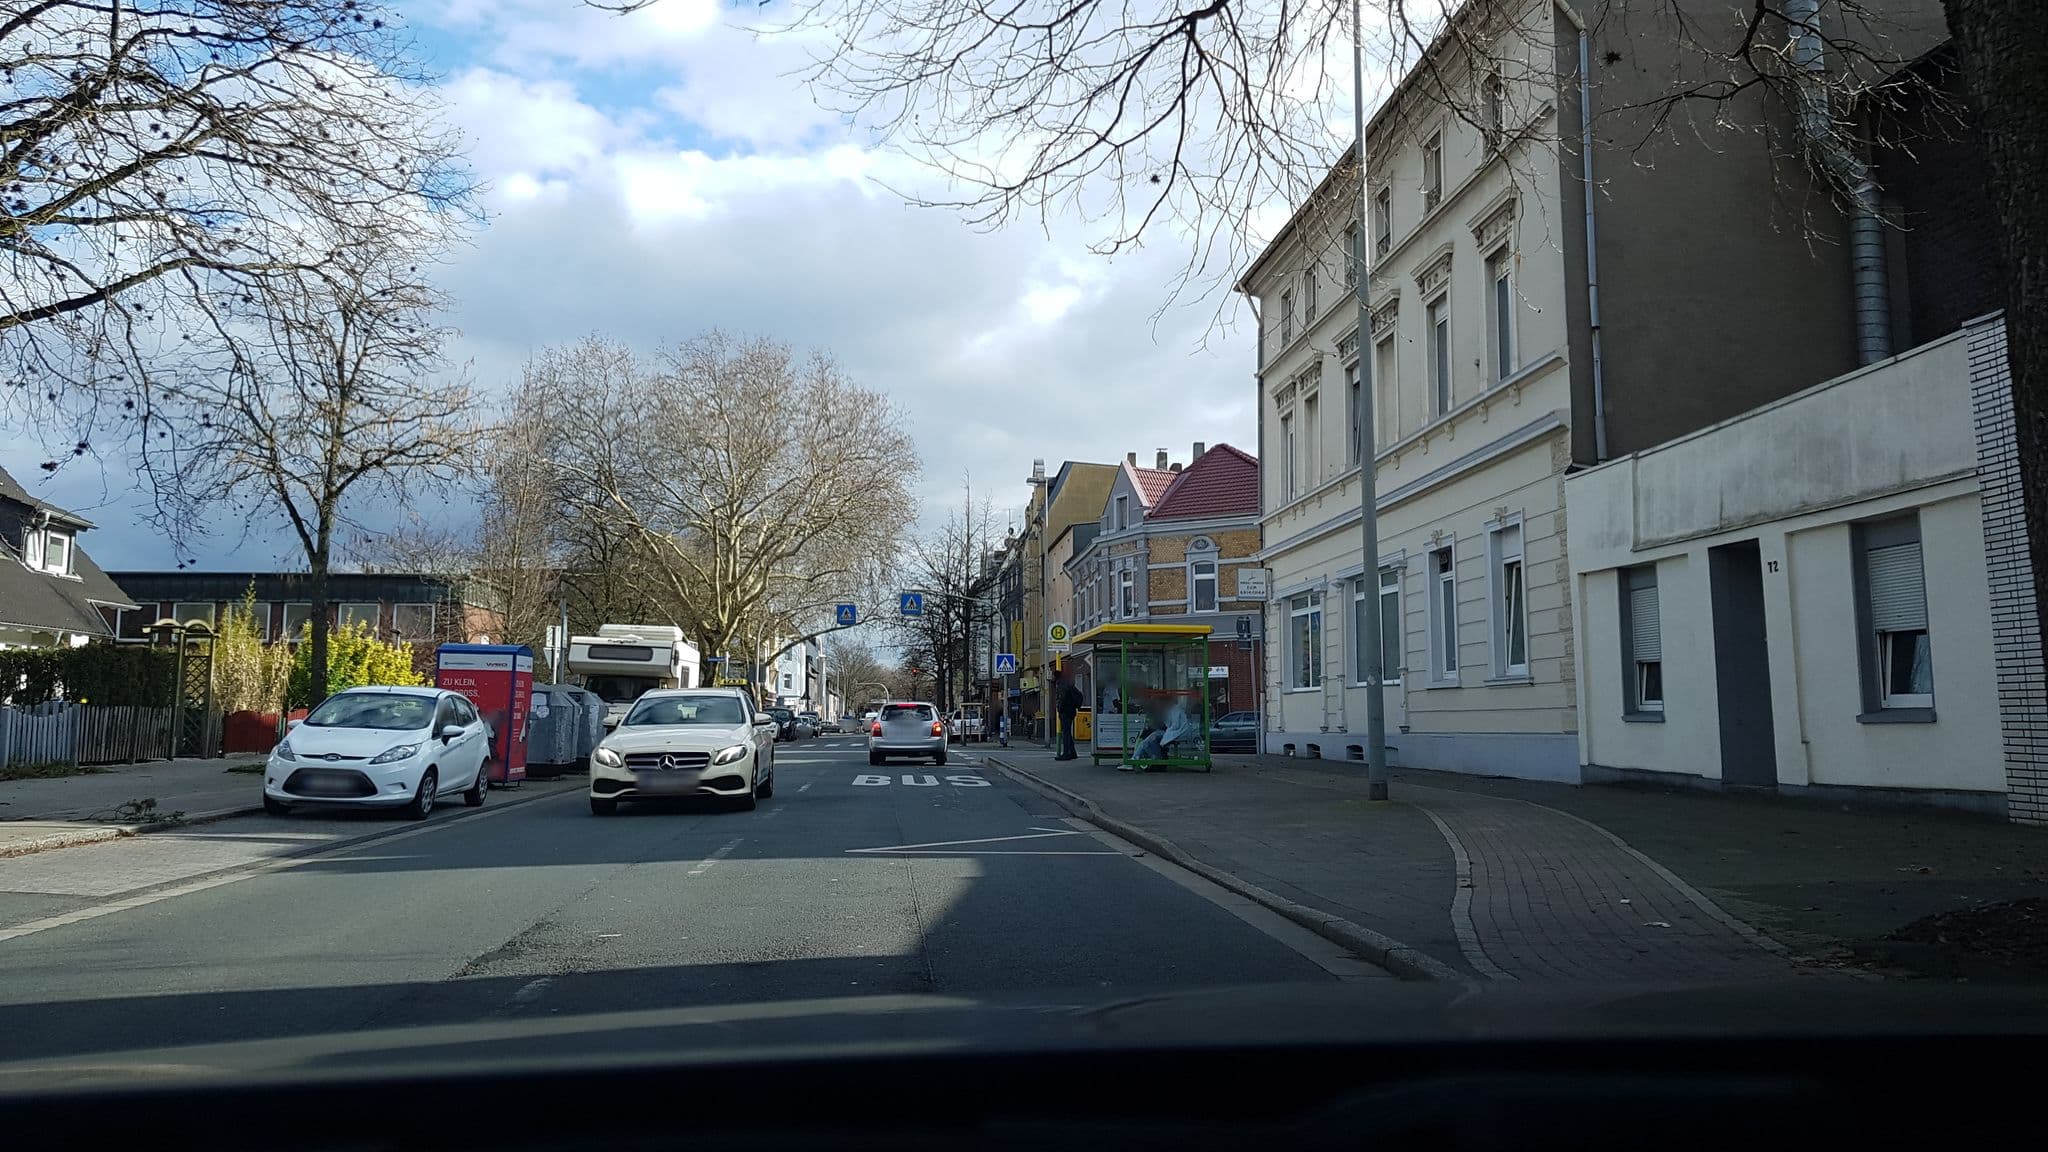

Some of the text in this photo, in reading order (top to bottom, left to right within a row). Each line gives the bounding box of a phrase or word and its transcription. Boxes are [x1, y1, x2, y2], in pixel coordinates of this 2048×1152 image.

[1767, 560, 1780, 574] 72
[1055, 628, 1063, 637] H
[443, 678, 453, 686] ZU
[851, 774, 992, 787] BUS
